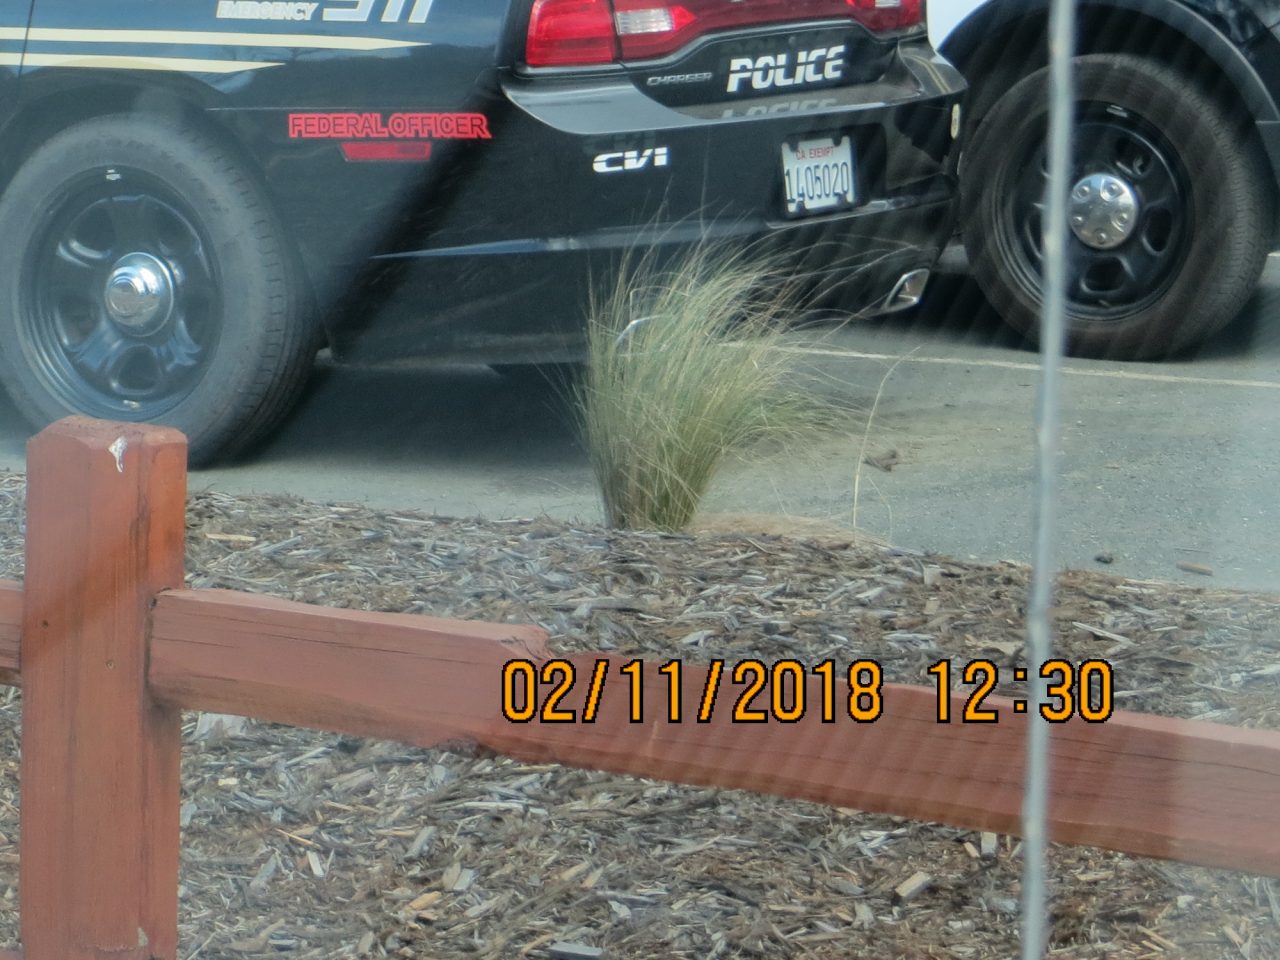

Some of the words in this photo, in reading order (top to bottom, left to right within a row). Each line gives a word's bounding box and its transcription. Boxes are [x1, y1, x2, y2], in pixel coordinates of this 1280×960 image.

[216, 0, 319, 21] EMERGENCY
[727, 44, 846, 93] POLICE
[288, 113, 388, 138] FEDERAL
[388, 112, 493, 139] OFFICER
[785, 161, 849, 204] 1405020
